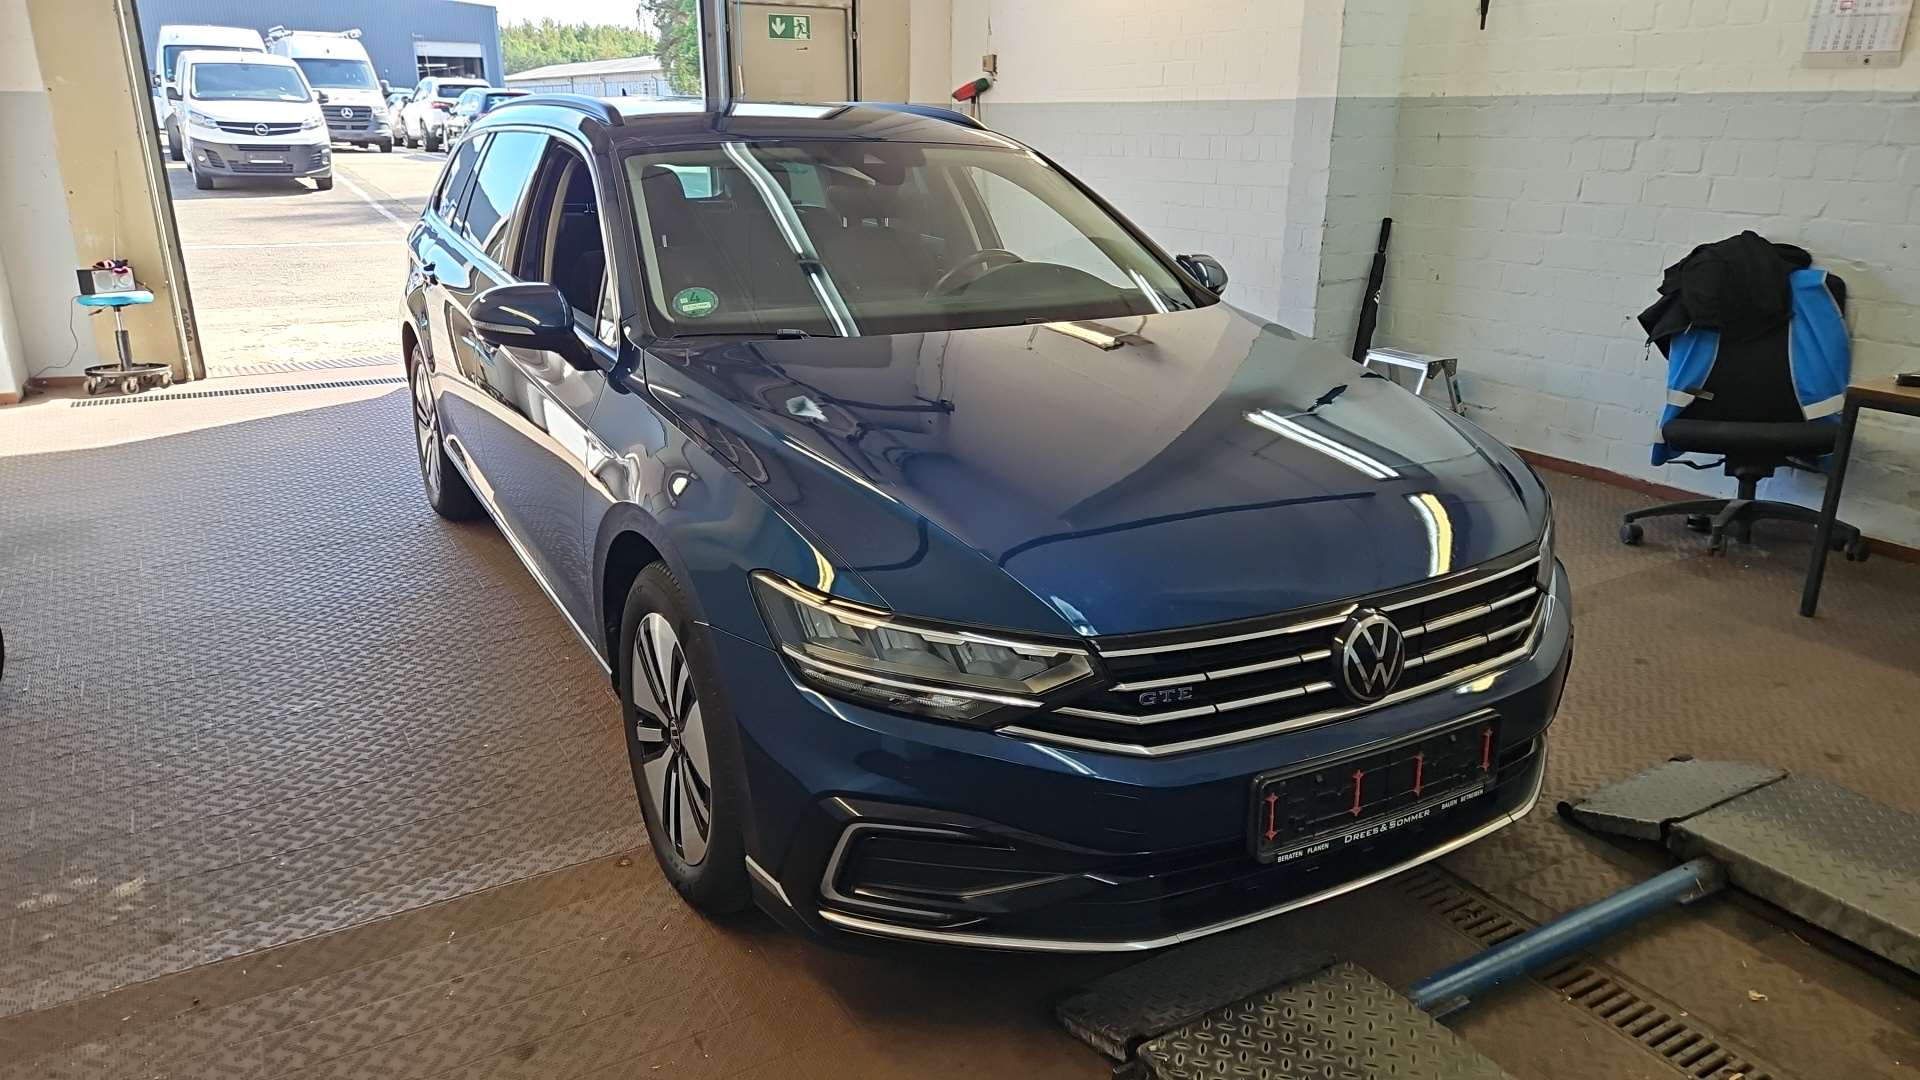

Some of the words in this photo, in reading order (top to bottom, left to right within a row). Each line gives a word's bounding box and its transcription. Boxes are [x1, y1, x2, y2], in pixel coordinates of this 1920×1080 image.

[1138, 686, 1193, 706] GTE
[1277, 851, 1304, 863] BERATEN
[1306, 842, 1330, 855] PLANEN
